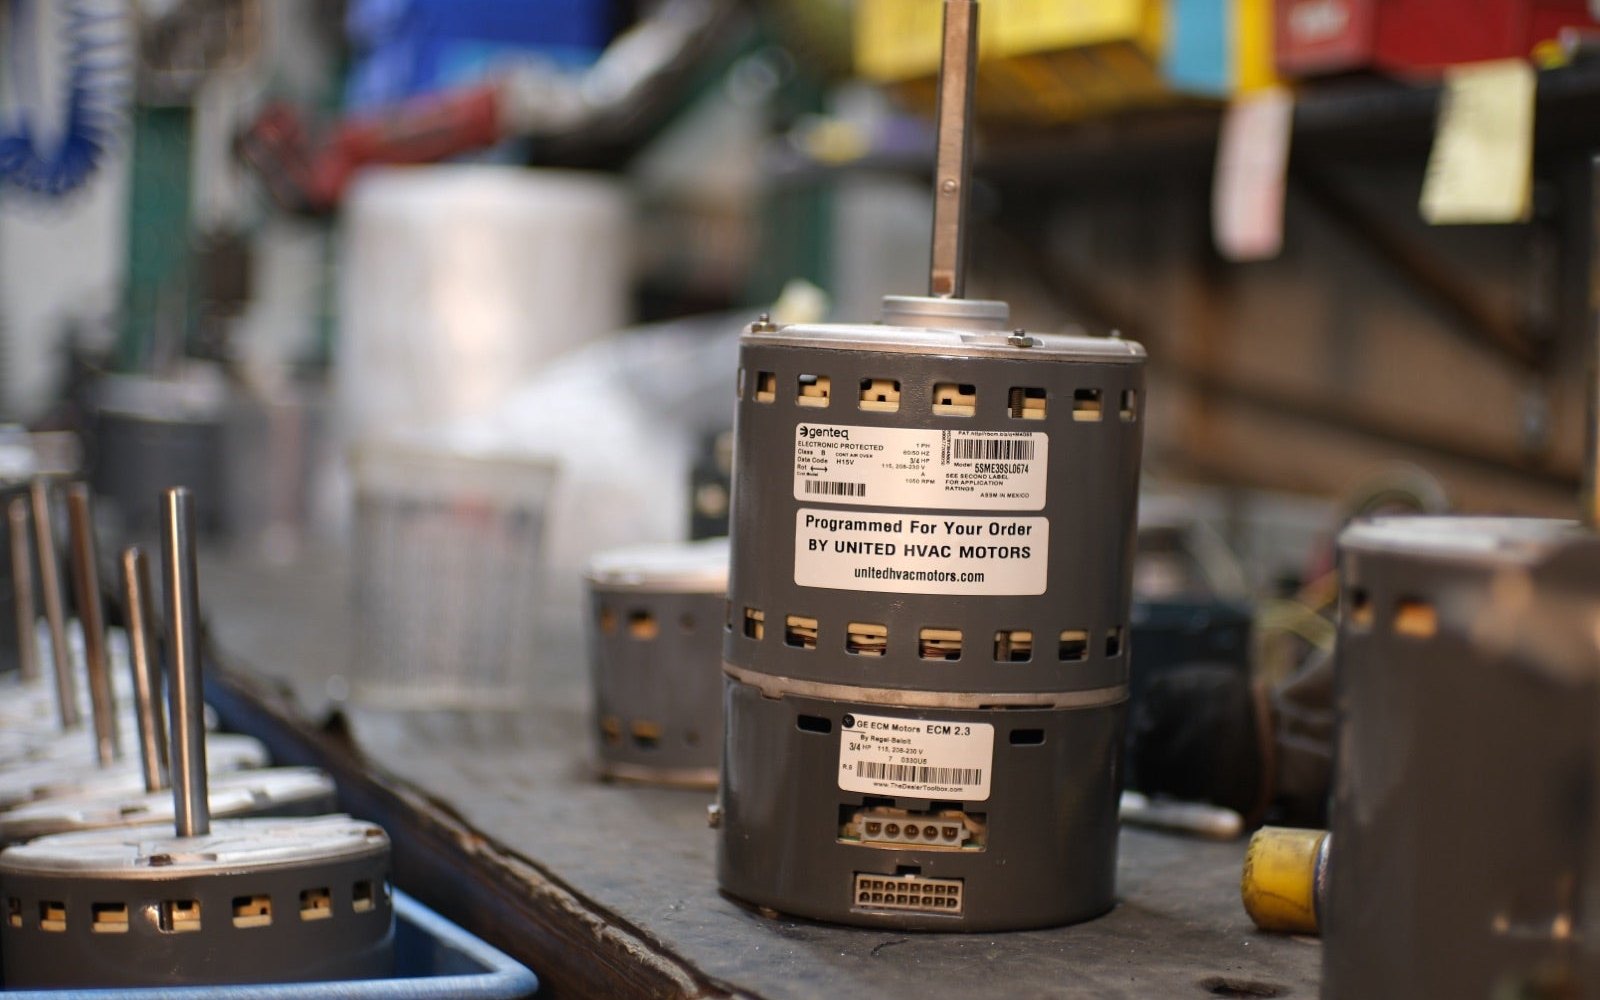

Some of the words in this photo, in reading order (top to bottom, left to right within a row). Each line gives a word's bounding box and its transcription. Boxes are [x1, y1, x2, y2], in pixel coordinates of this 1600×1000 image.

[809, 427, 849, 440] genteq
[797, 441, 838, 449] ELECTRONIC
[975, 463, 1029, 474] 5SME39SL0674
[806, 515, 902, 533] Programmed
[910, 521, 937, 534] For
[944, 522, 983, 536] Your
[989, 522, 1032, 536] Order
[808, 539, 828, 551] BY
[835, 541, 896, 556] UNITED
[904, 544, 951, 557] HVAC
[959, 546, 1031, 559] MOTORS
[854, 567, 985, 583] unitedhvacmotors.com
[871, 722, 889, 730] ECM
[892, 724, 921, 733] Motors
[926, 725, 951, 735] ECM
[954, 726, 971, 736] 2.3
[870, 735, 911, 744] Regal-Beloit
[849, 742, 861, 751] 3/4
